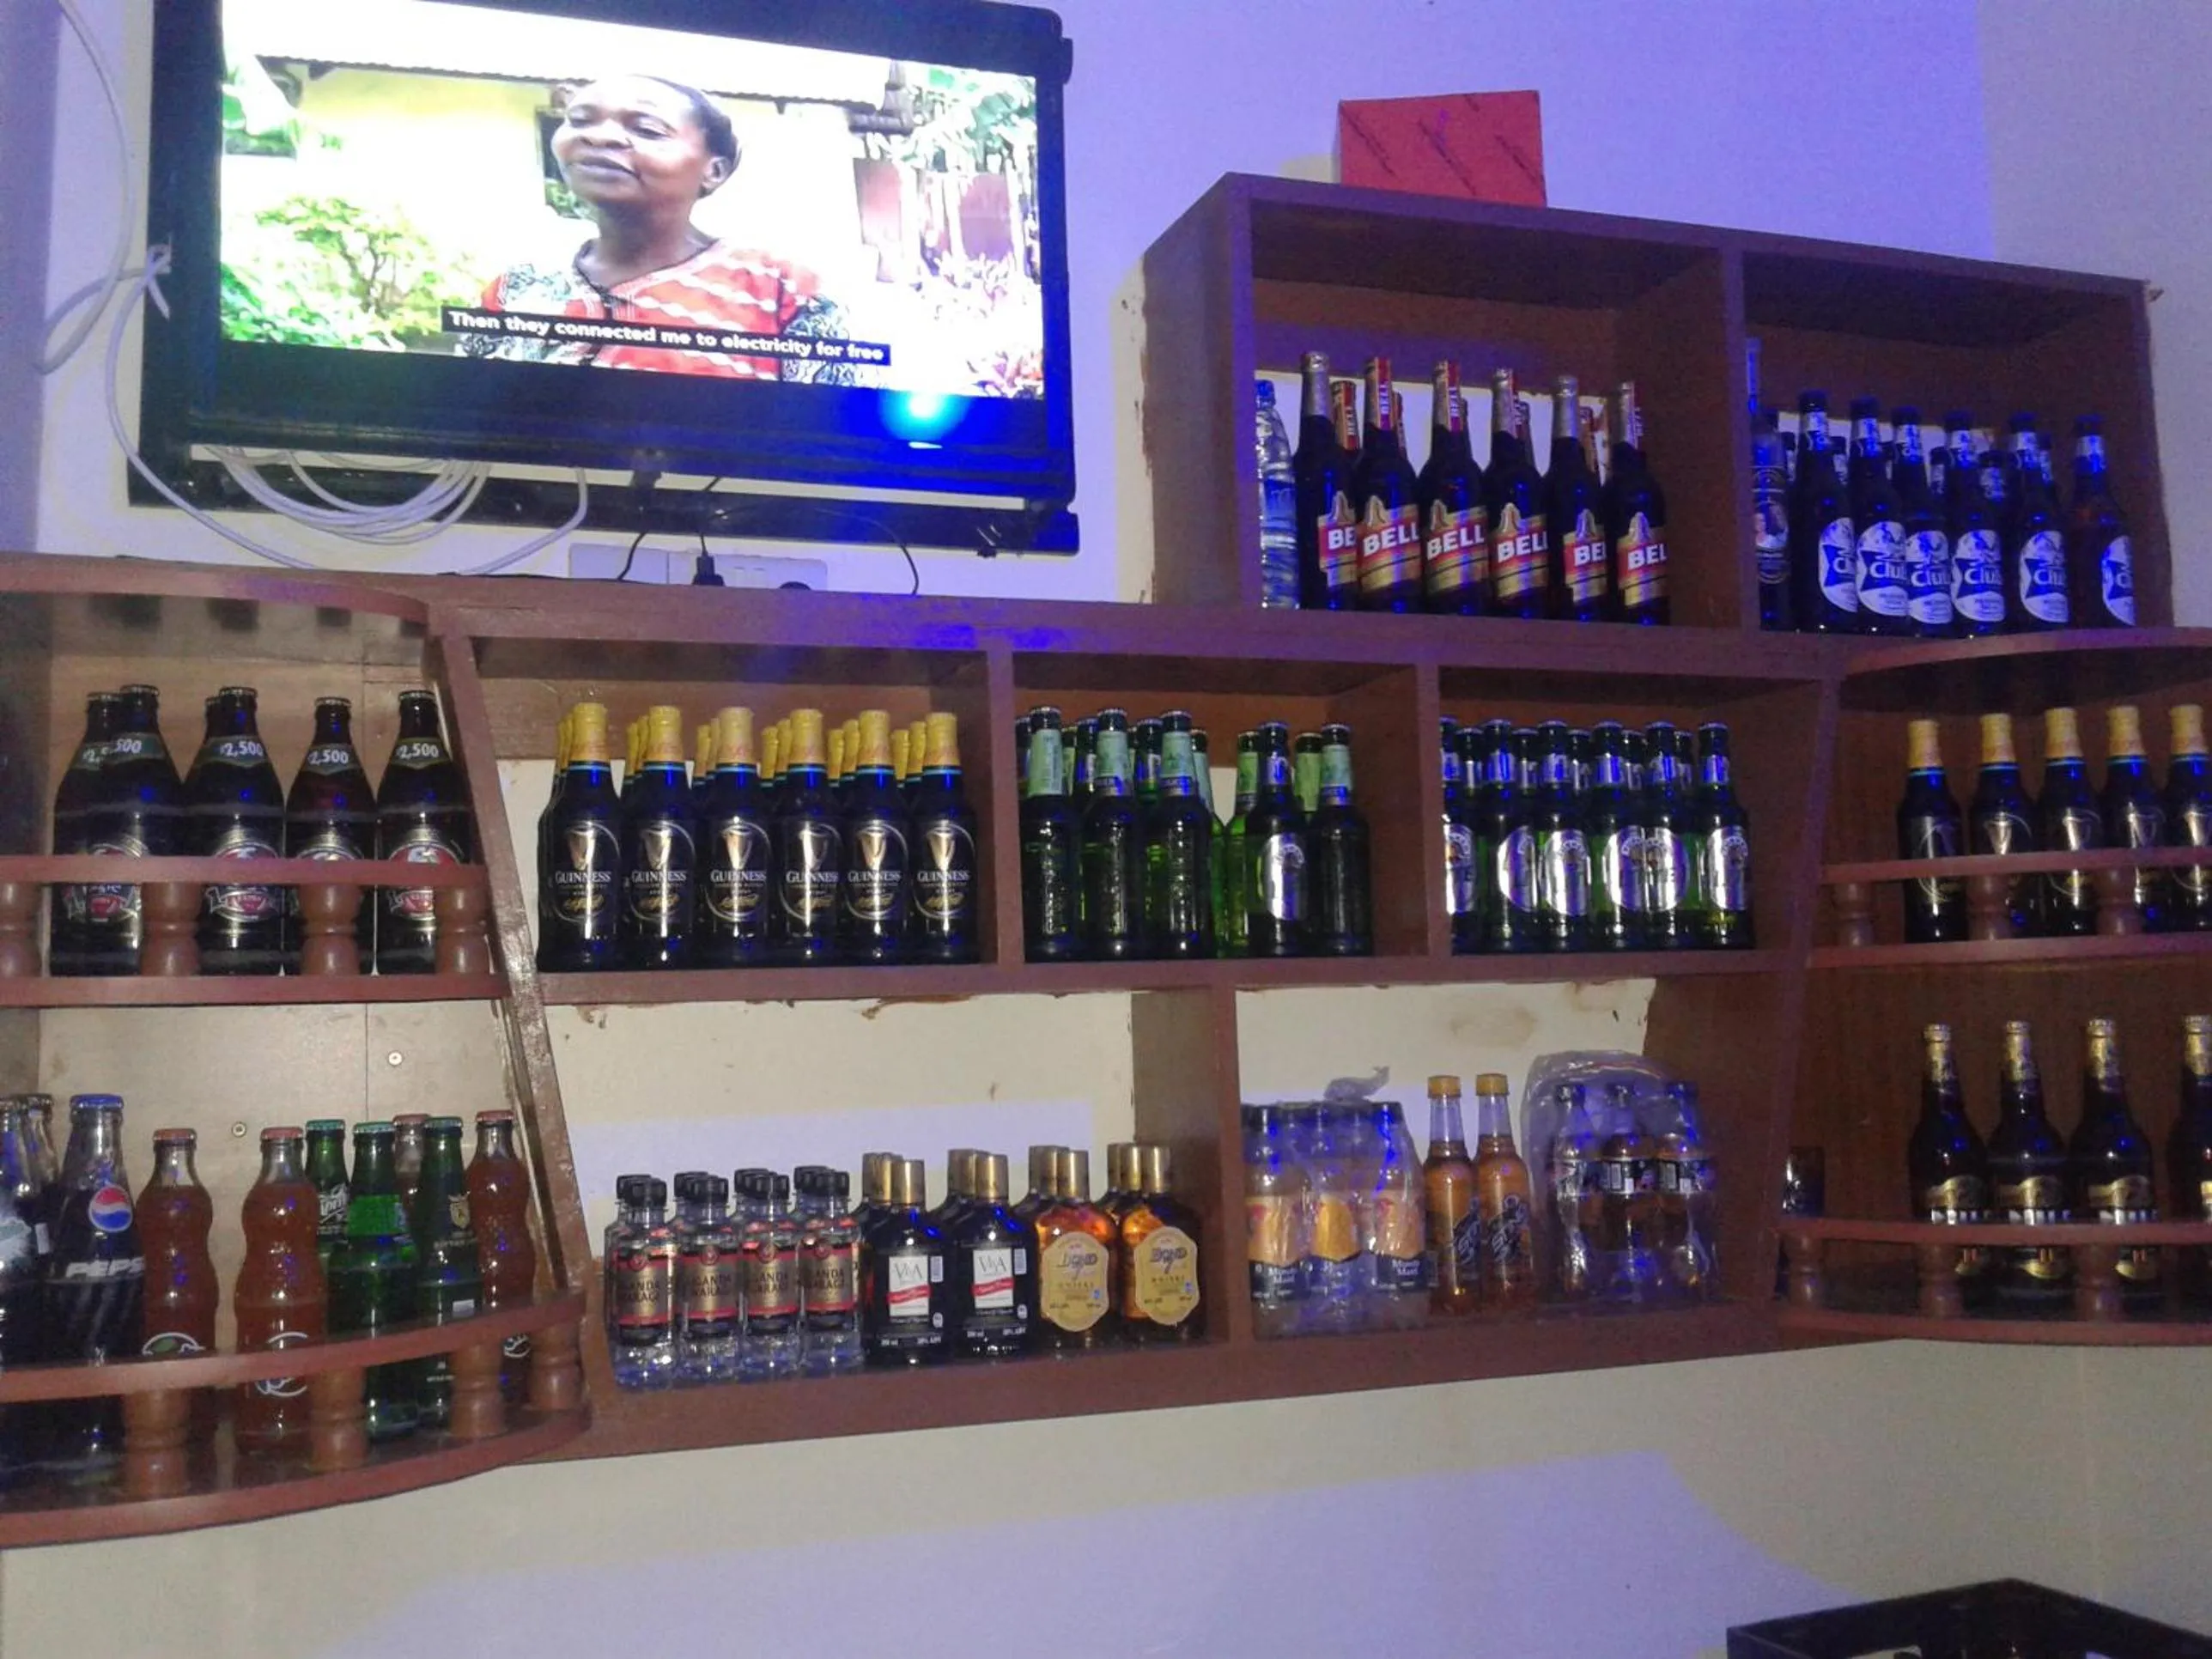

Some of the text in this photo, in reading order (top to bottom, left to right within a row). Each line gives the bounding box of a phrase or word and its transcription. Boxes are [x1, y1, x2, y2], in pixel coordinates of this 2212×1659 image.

[448, 310, 884, 360] Then they connected me to electricity for free
[1328, 526, 1357, 550] BE
[1363, 522, 1419, 556] BELL
[1427, 525, 1485, 560] BELL
[1574, 541, 1606, 567] BE
[1627, 543, 1667, 570] BEL
[311, 749, 349, 765] 2,500
[400, 743, 439, 759] 2,500
[556, 870, 611, 883] GUINNESS
[632, 870, 687, 883] GUINNESS
[710, 869, 767, 882] GUINNESS
[848, 870, 901, 883] GUINNESS
[917, 870, 970, 883] GUINNESS
[66, 1255, 146, 1278] PEPS
